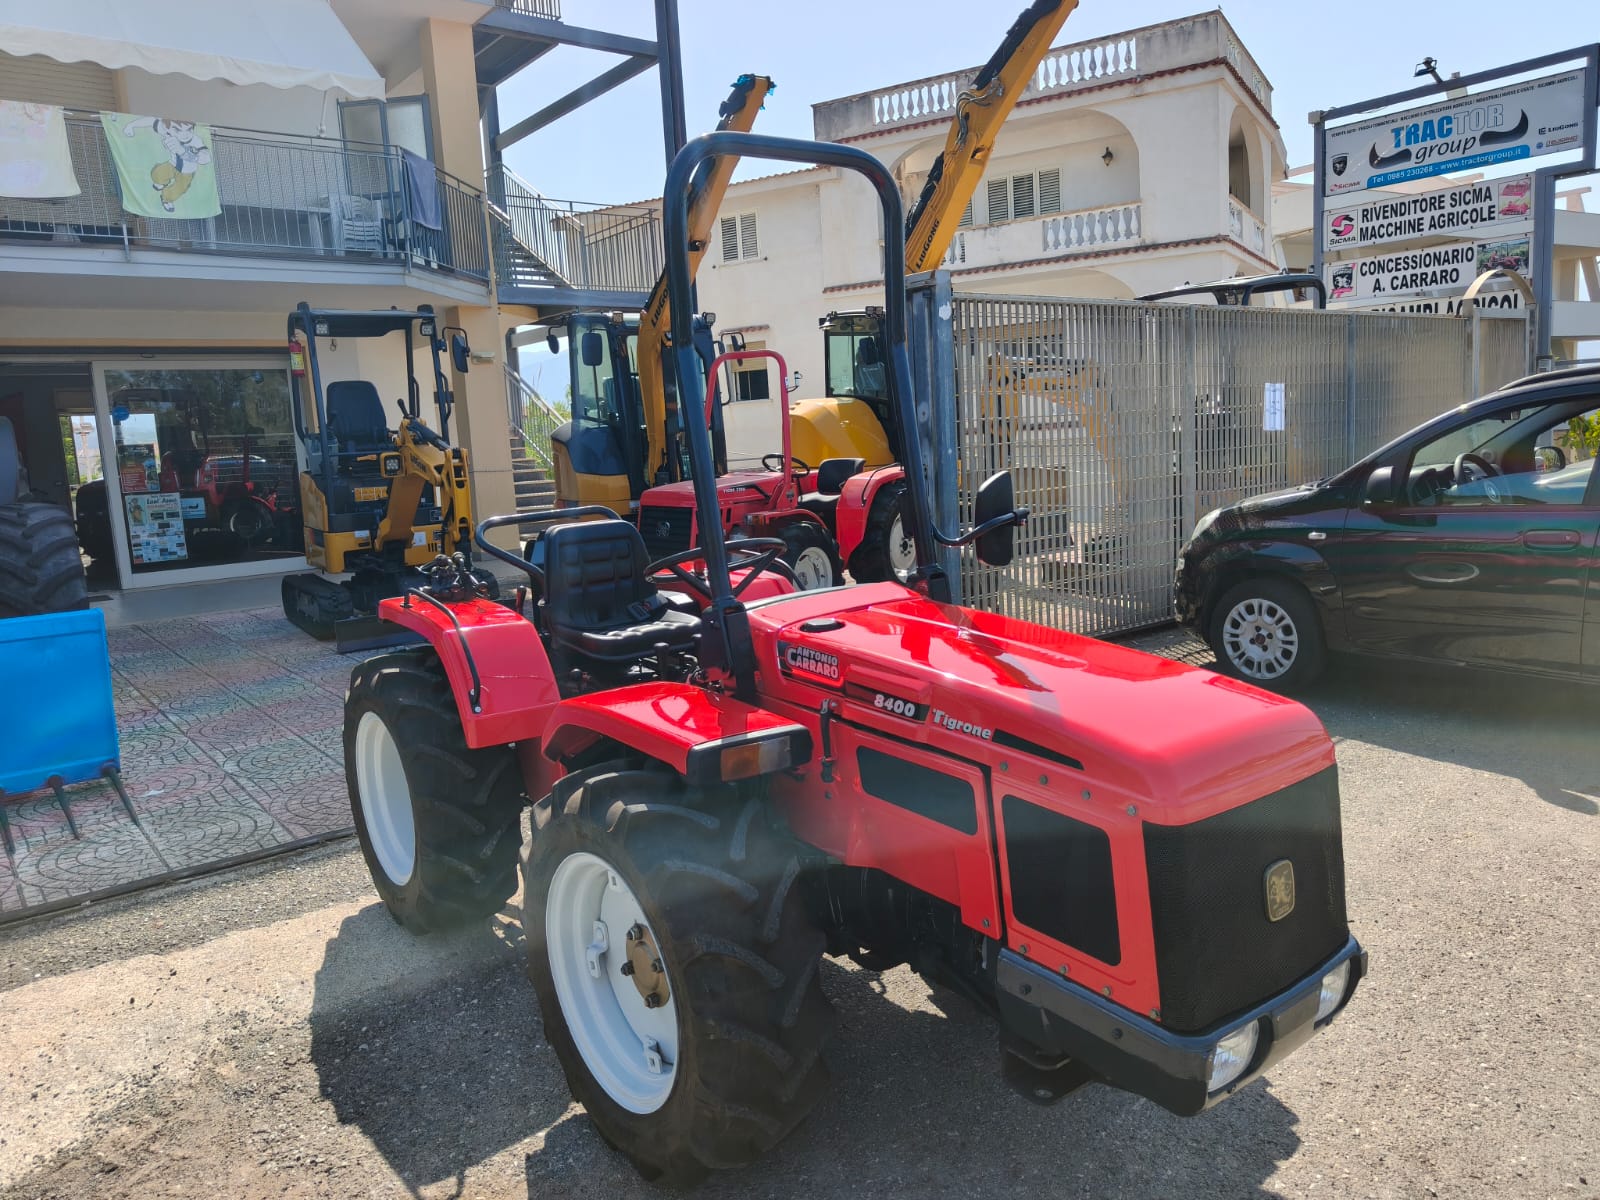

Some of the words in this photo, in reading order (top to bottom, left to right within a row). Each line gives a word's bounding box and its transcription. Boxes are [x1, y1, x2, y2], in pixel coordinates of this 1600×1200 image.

[1391, 104, 1504, 148] TRACTOR
[1414, 136, 1477, 164] group
[1440, 147, 1521, 170] www.tractorgroup.it
[1361, 194, 1445, 223] RIVENDITORE
[1450, 186, 1492, 208] SICMA
[1359, 216, 1424, 241] MACCHINE
[1428, 204, 1496, 231] AGRICOLE
[1329, 236, 1356, 246] SICMA
[1359, 246, 1474, 277] CONCESSIONARIO
[1372, 278, 1386, 293] A.
[1390, 268, 1460, 291] CARRARO
[787, 648, 839, 679] CARRARO
[796, 646, 838, 666] ANTONIO
[873, 693, 916, 718] 8400
[932, 708, 992, 739] Tigrone
